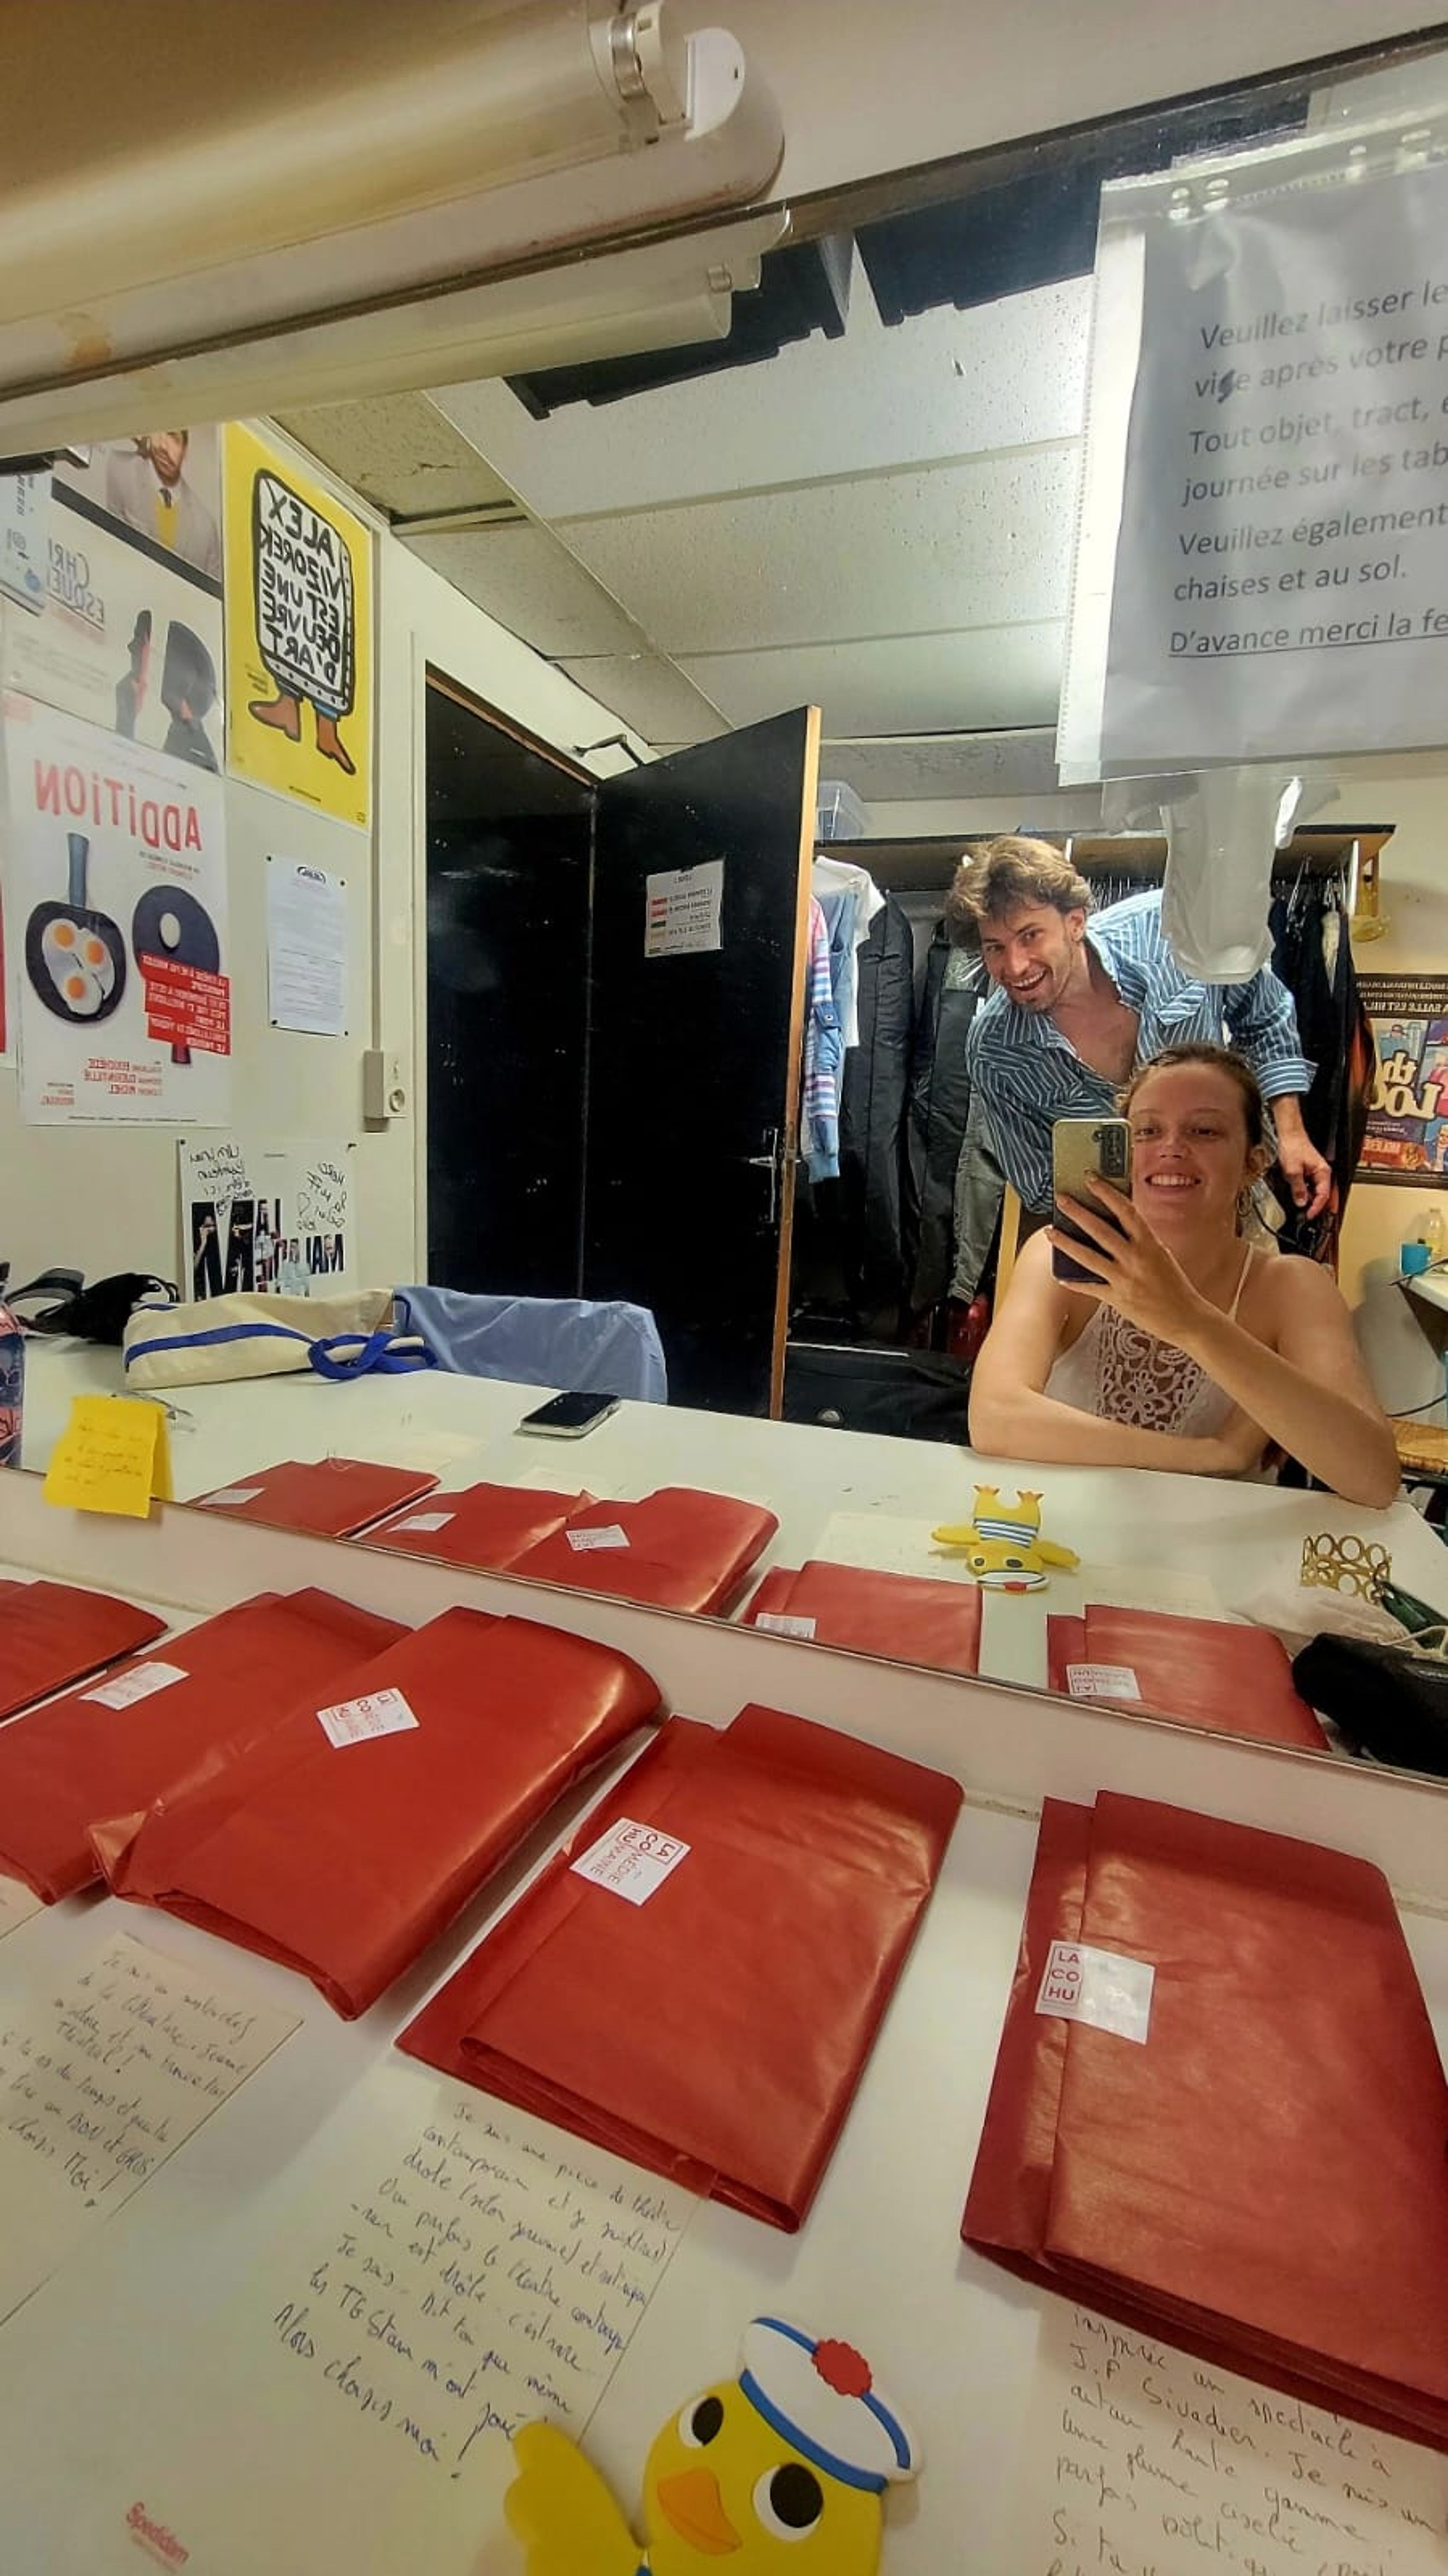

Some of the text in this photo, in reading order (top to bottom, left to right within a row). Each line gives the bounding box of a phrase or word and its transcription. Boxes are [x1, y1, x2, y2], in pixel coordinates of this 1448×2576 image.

[1201, 310, 1308, 350] Veuillez
[1318, 287, 1414, 329] laisser
[1259, 356, 1340, 391] après
[1349, 335, 1429, 371] votre
[1189, 395, 1430, 455] Tout objet, tract,
[1182, 470, 1290, 508] journée
[1298, 460, 1341, 486] sur
[1351, 448, 1392, 476] les
[1179, 502, 1448, 556] Veuillez également
[1173, 554, 1407, 602] chaises et au sol.
[1299, 613, 1378, 646] merci
[1388, 613, 1413, 637] la
[1052, 1968, 1080, 1982] CO
[1058, 1950, 1080, 1963] LA
[1048, 1986, 1074, 2000] HU
[1288, 2450, 1327, 2488] Je
